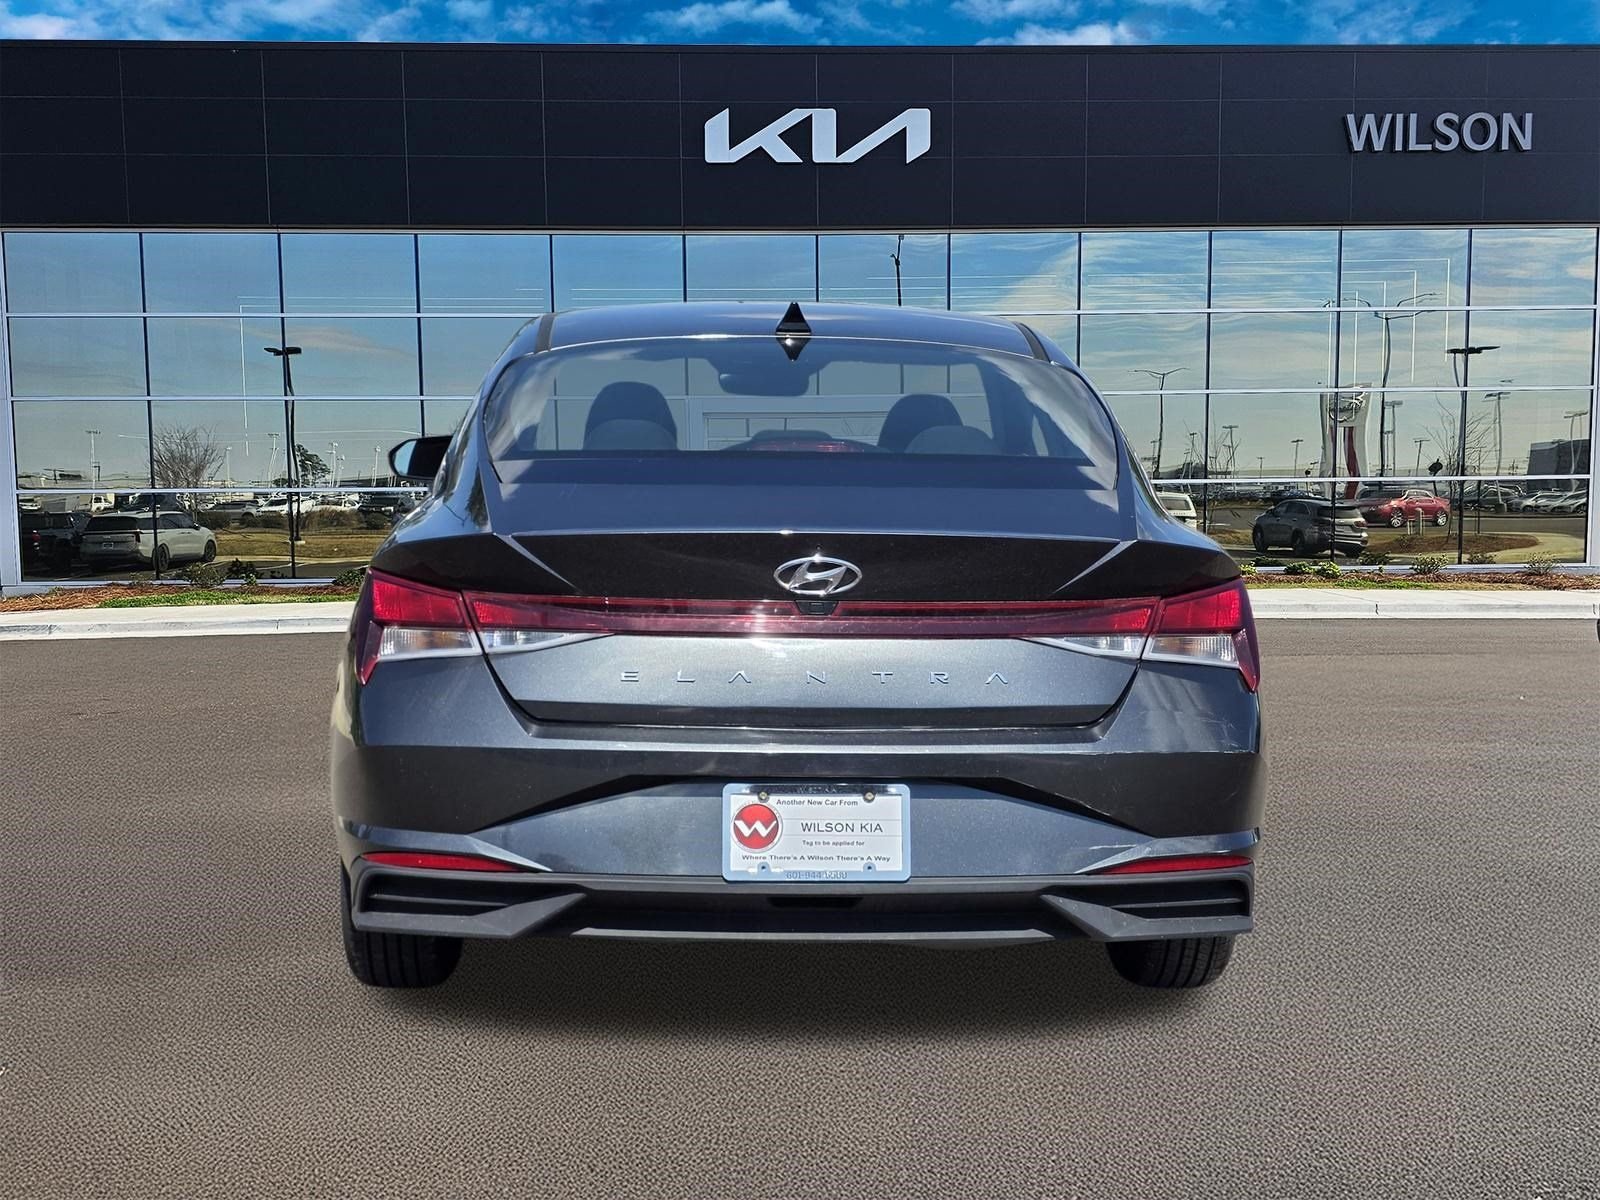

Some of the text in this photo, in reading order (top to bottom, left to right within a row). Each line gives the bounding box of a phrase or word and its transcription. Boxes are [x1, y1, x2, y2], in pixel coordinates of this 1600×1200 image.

[704, 107, 931, 164] KIA
[1346, 112, 1533, 152] WILSON
[620, 670, 1008, 684] ELANTRA
[801, 822, 883, 833] WILSON KIA
[802, 839, 813, 847] Tag
